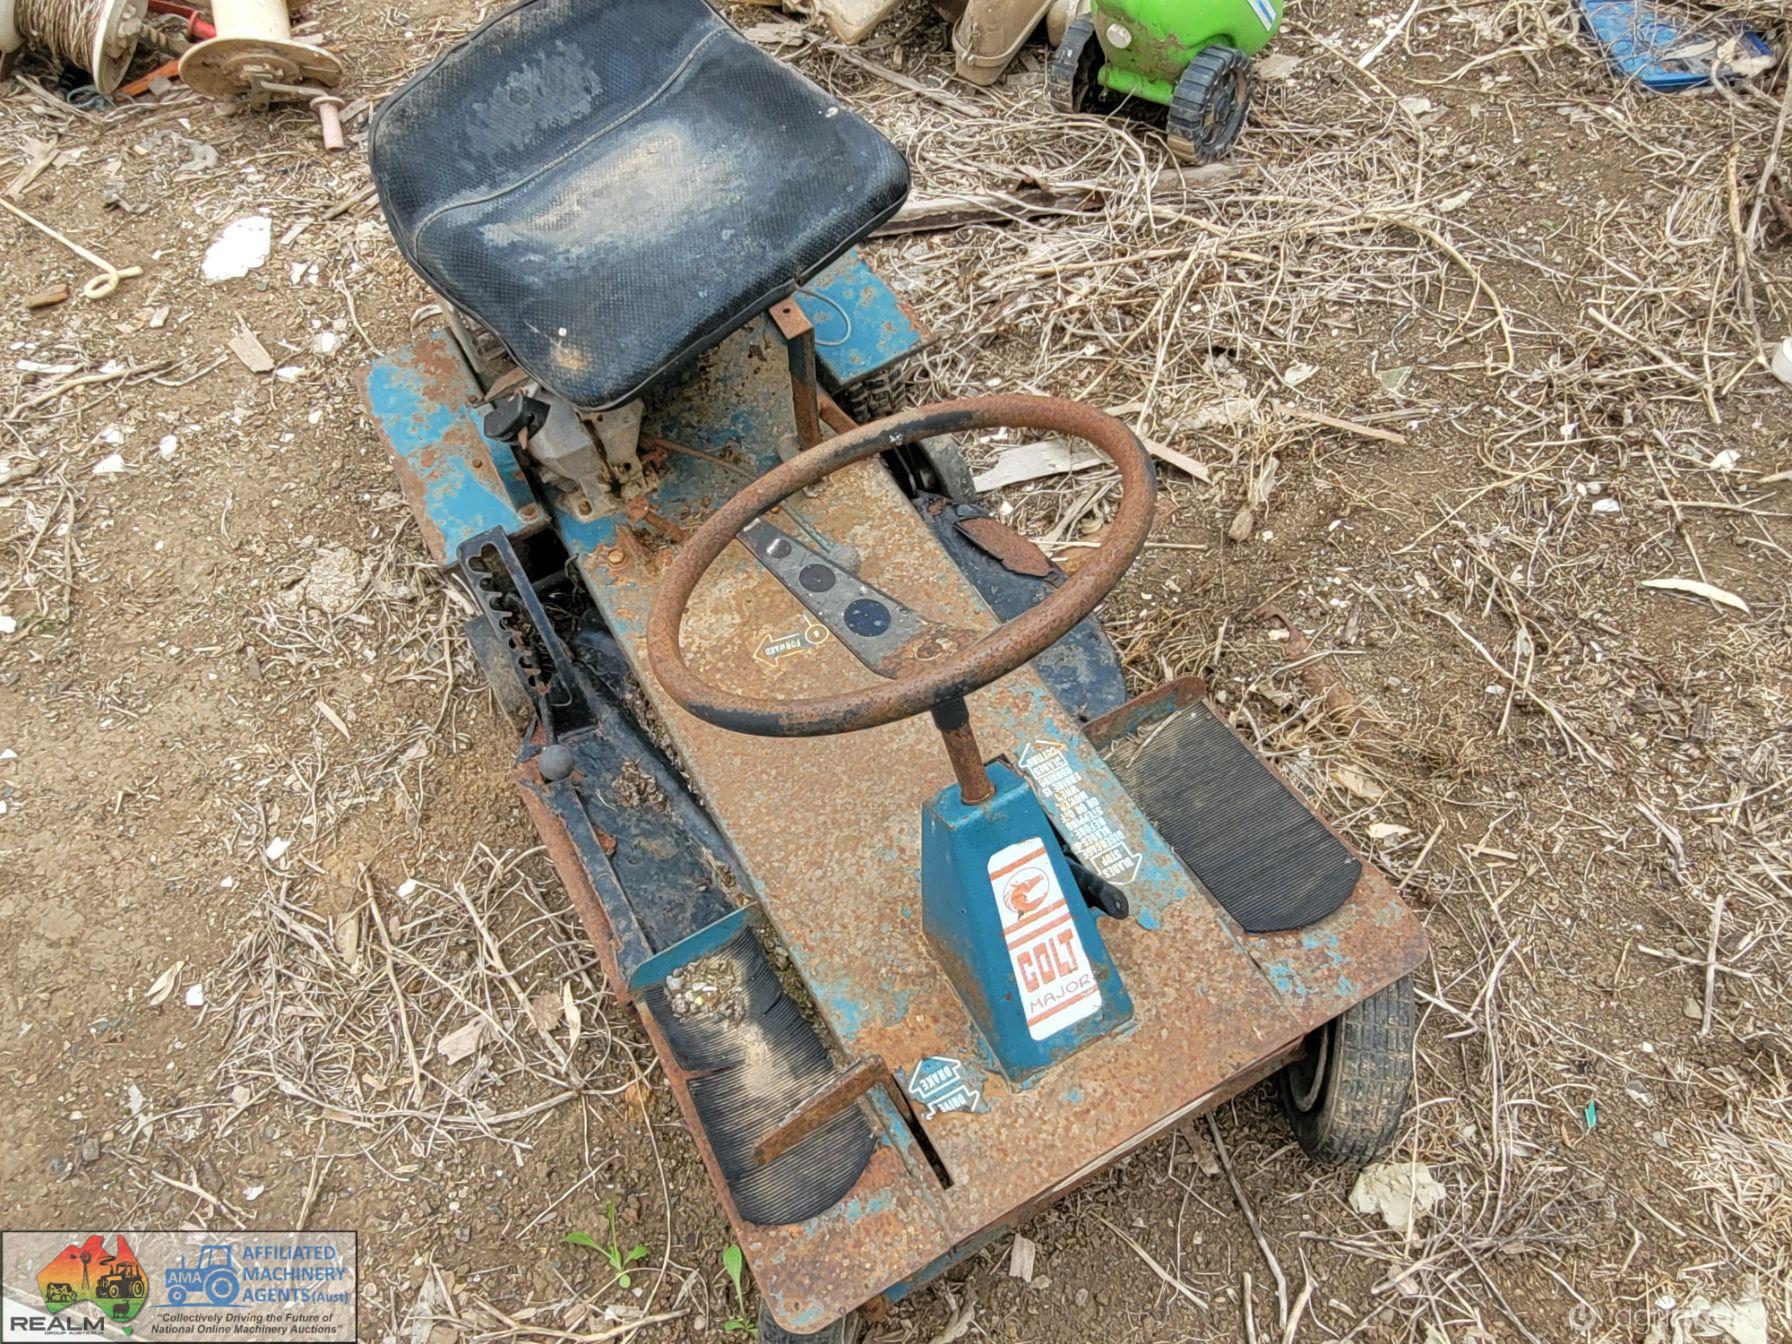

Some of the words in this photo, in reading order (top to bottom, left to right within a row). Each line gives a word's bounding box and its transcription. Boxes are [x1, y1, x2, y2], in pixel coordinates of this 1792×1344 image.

[765, 638, 801, 655] FORWARD
[1065, 806, 1103, 831] STEPPING
[1081, 826, 1111, 846] BLADES
[1081, 830, 1124, 858] DISENGAGE
[1100, 848, 1121, 865] STOP
[1103, 856, 1133, 878] BLADES
[1016, 928, 1079, 993] COLT
[1029, 973, 1091, 1013] MAJOR
[919, 1066, 952, 1091] BRAKE
[937, 1093, 966, 1112] DRIVE
